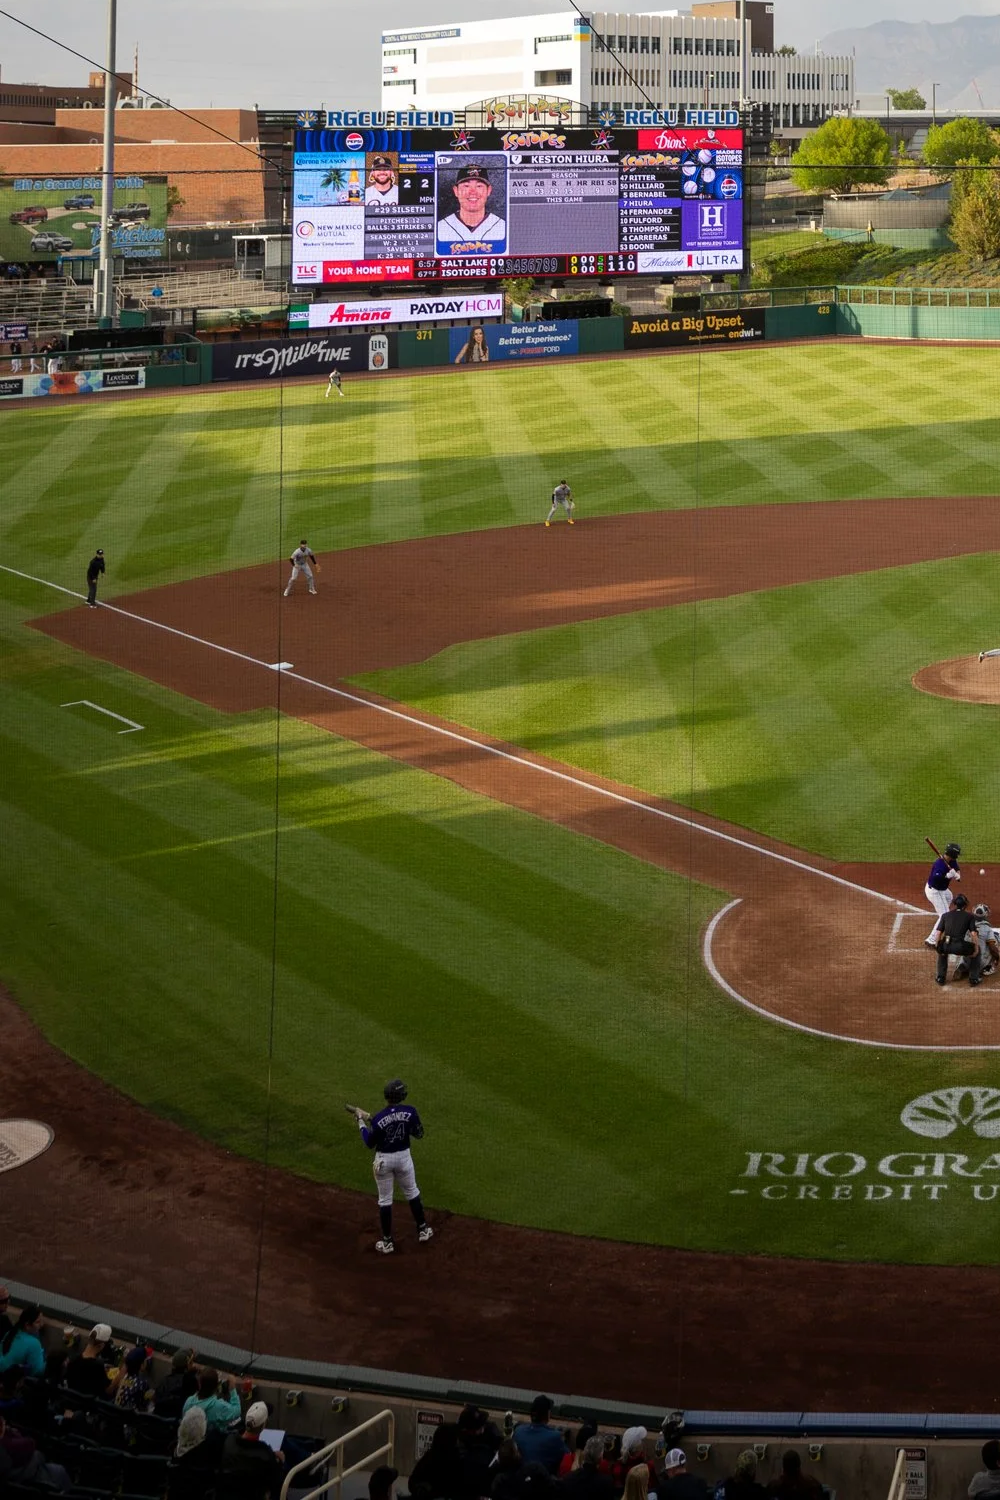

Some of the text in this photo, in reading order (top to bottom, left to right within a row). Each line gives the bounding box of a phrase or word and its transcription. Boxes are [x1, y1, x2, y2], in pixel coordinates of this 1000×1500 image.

[326, 110, 455, 128] RGCU FIELD
[623, 109, 739, 127] RGCU FIELD
[531, 155, 610, 164] KESTON HIURA
[14, 179, 33, 190] Hit
[34, 181, 43, 190] a
[44, 178, 83, 190] Grand
[116, 176, 144, 189] with
[403, 179, 429, 188] 2 2
[701, 206, 723, 227] H
[90, 226, 166, 247] Pfection
[608, 261, 636, 271] 1 1 0
[696, 255, 738, 266] ULTRA
[297, 265, 410, 276] TLC YOUR HOME TEAM
[442, 268, 487, 277] ISOTOPES
[410, 299, 500, 315] PAYDAY HCM
[817, 305, 830, 315] 428
[329, 304, 392, 324] Amana
[511, 324, 558, 334] Better Deal.
[631, 315, 744, 334] Avoid a Big Upset.
[416, 330, 432, 340] 371
[728, 328, 754, 338] endwi
[371, 340, 386, 352] Lite
[498, 338, 523, 346] Better
[235, 352, 262, 369] IT'S
[261, 339, 329, 375] Miller
[317, 347, 352, 362] TIME
[378, 1112, 412, 1130] FERNANDEZ
[738, 1152, 866, 1178] RIO
[760, 1184, 950, 1200] CREDIT
